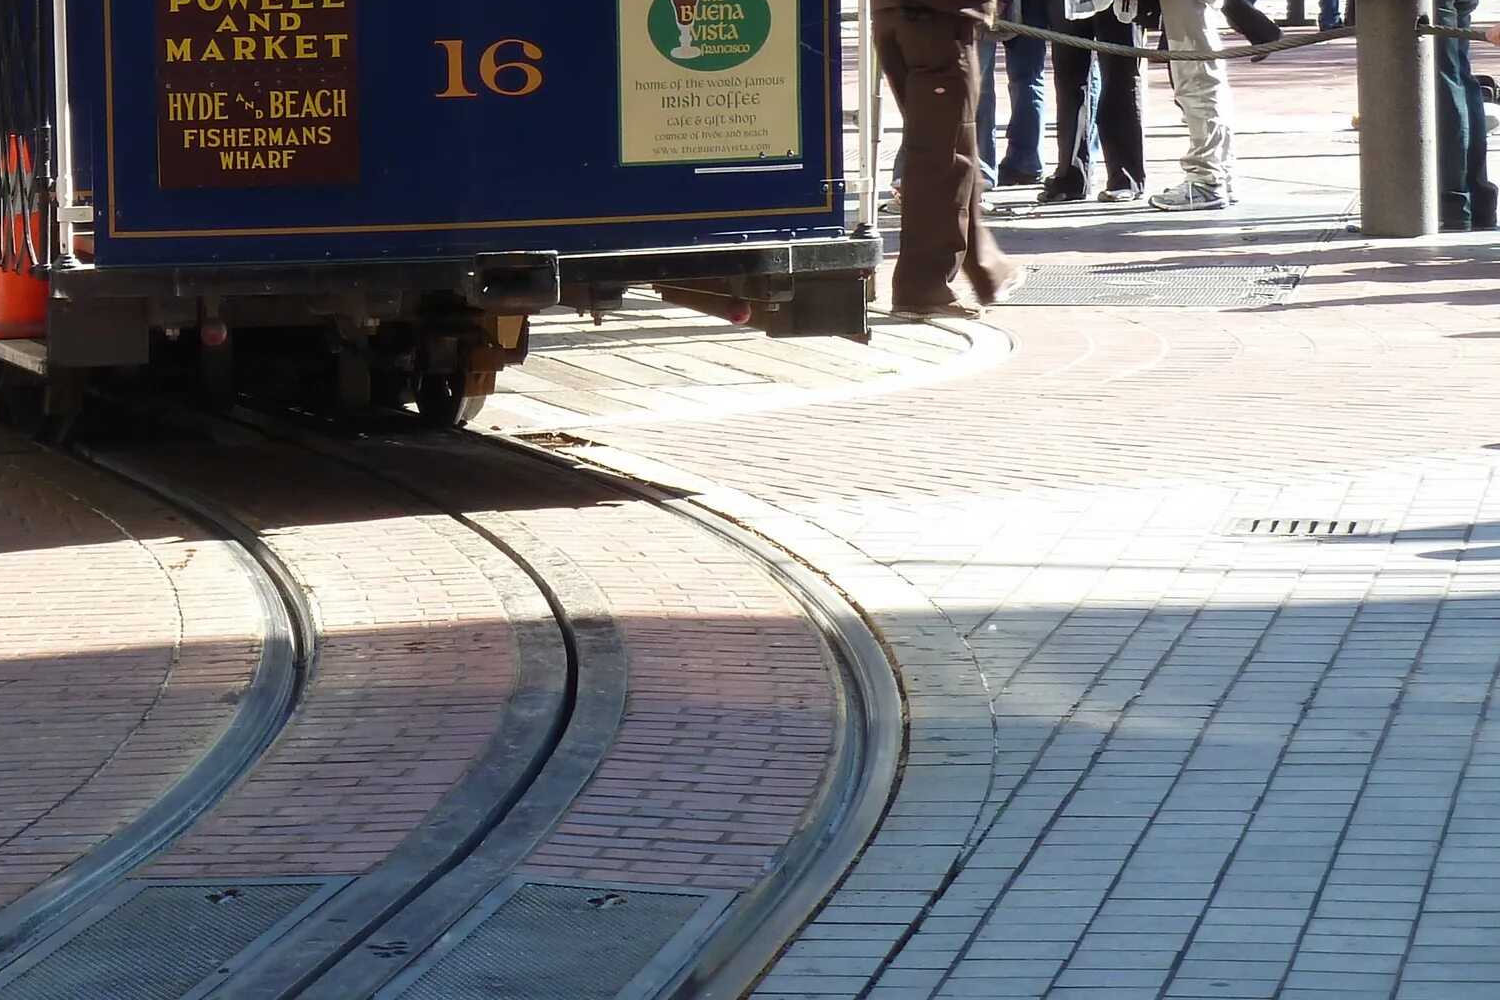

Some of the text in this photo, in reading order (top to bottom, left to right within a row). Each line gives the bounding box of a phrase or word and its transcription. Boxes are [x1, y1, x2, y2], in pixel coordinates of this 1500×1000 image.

[215, 12, 302, 33] AND
[165, 34, 348, 62] MARKET
[433, 39, 543, 98] 16
[635, 80, 667, 91] home
[670, 79, 683, 91] of
[685, 77, 704, 89] the
[167, 89, 347, 121] HYDE AND BEACH
[695, 115, 702, 126] &
[729, 112, 757, 125] shop
[183, 126, 332, 149] FISHERMANS
[219, 149, 297, 170] WHARF
